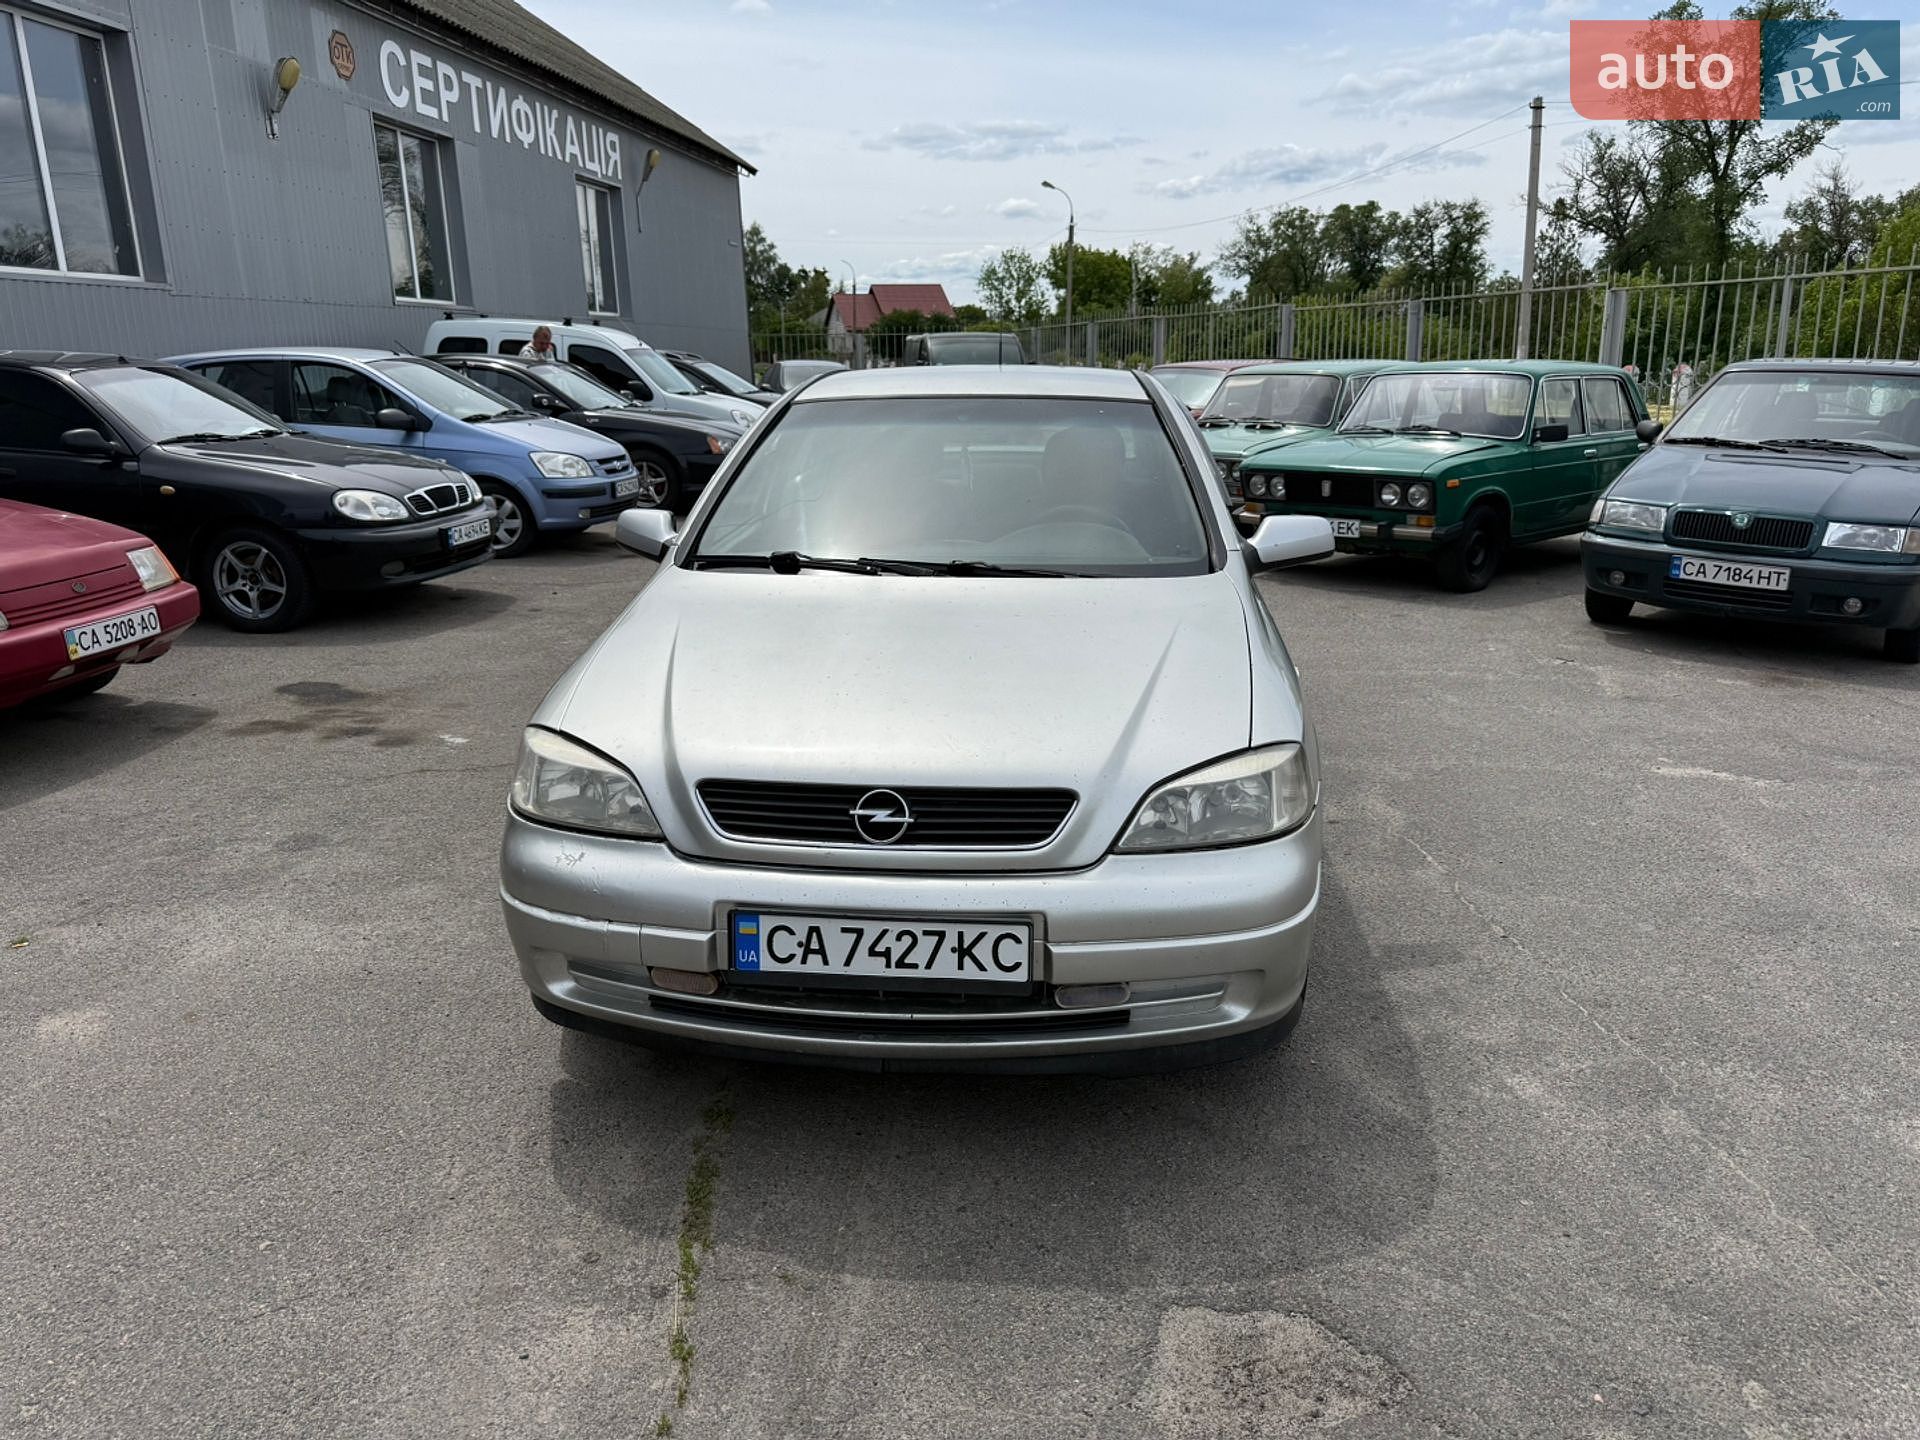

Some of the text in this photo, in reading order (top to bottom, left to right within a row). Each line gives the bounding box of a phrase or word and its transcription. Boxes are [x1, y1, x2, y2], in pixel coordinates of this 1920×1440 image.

[379, 39, 623, 180] СЕРТИФІКАЦІЯ
[1337, 521, 1355, 536] EK
[1682, 561, 1787, 587] CA 7184 HT
[78, 612, 158, 651] CA 5208 AO
[738, 949, 758, 962] UA
[766, 924, 1023, 972] CA 7427 KC
